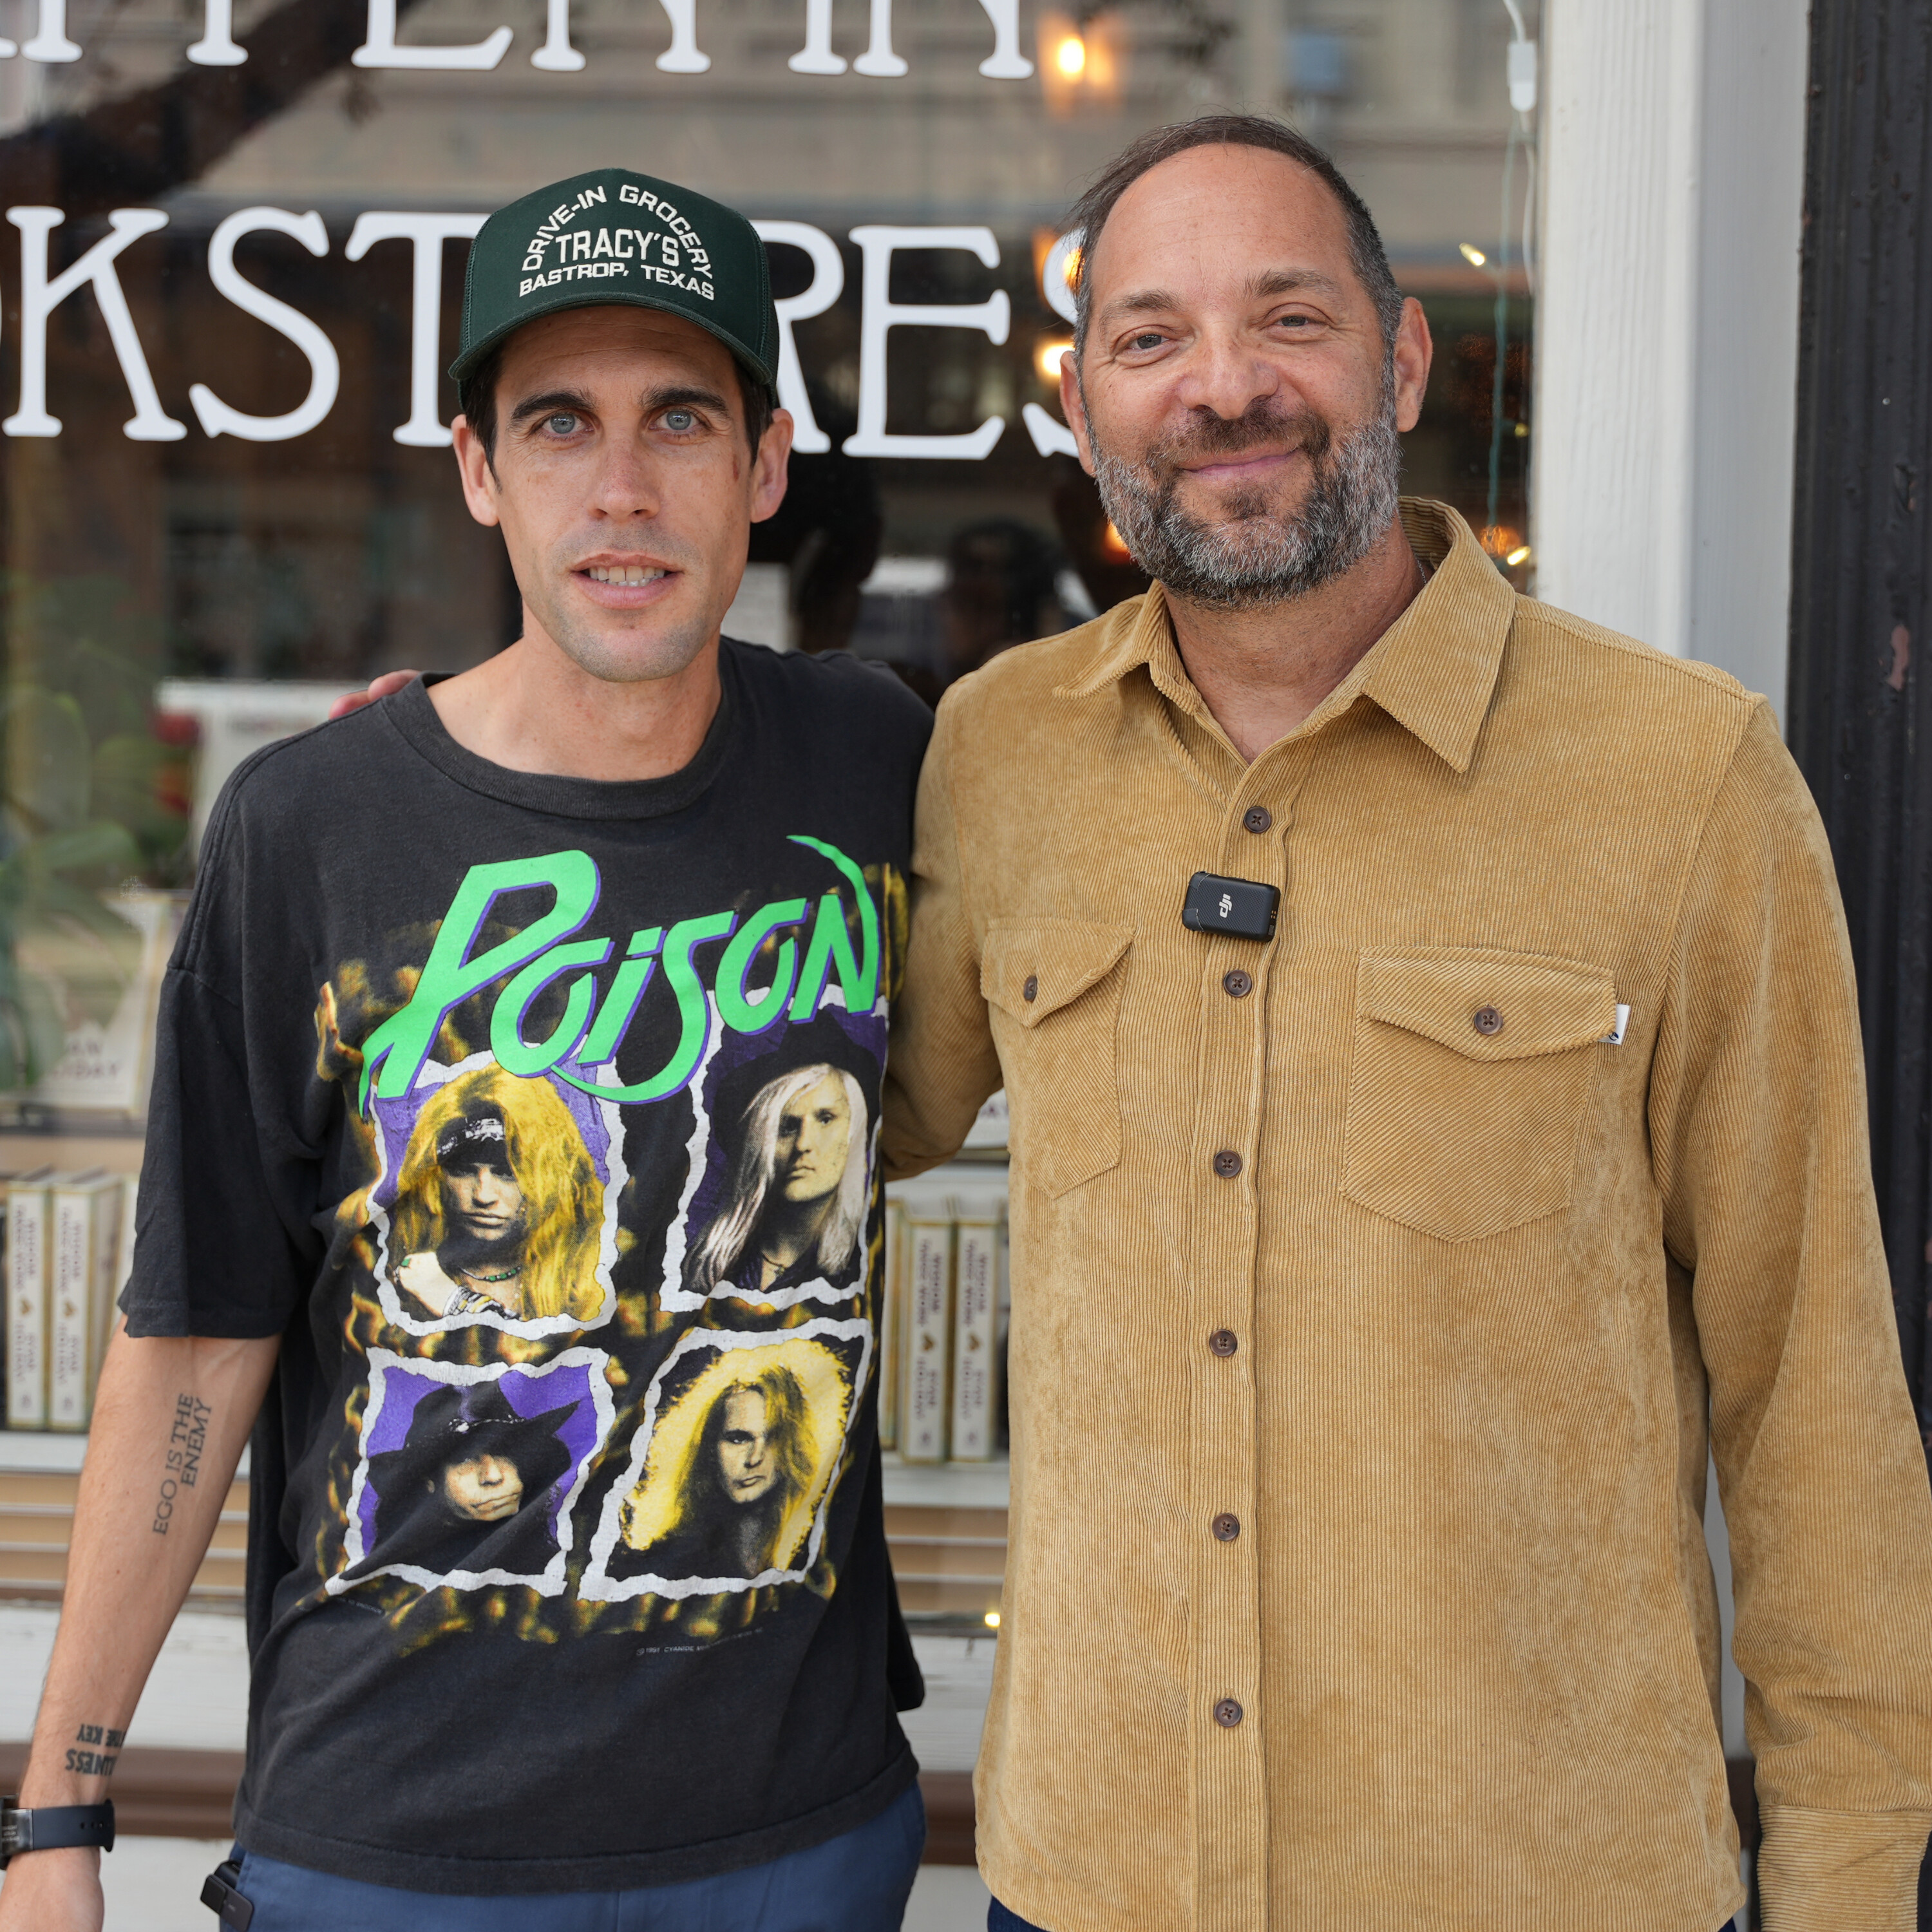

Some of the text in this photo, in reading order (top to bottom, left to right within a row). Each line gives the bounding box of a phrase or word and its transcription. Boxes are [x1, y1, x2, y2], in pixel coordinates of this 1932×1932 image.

[521, 184, 713, 279] DRIVE-IN GROCERY
[556, 228, 679, 267] TRACY'S
[519, 262, 715, 301] BASTROP, TEXAS
[180, 1397, 212, 1488] ENEMY
[153, 1393, 194, 1535] EGO IS THE
[663, 1645, 695, 1653] CYANIDE
[77, 1723, 103, 1745] KEY
